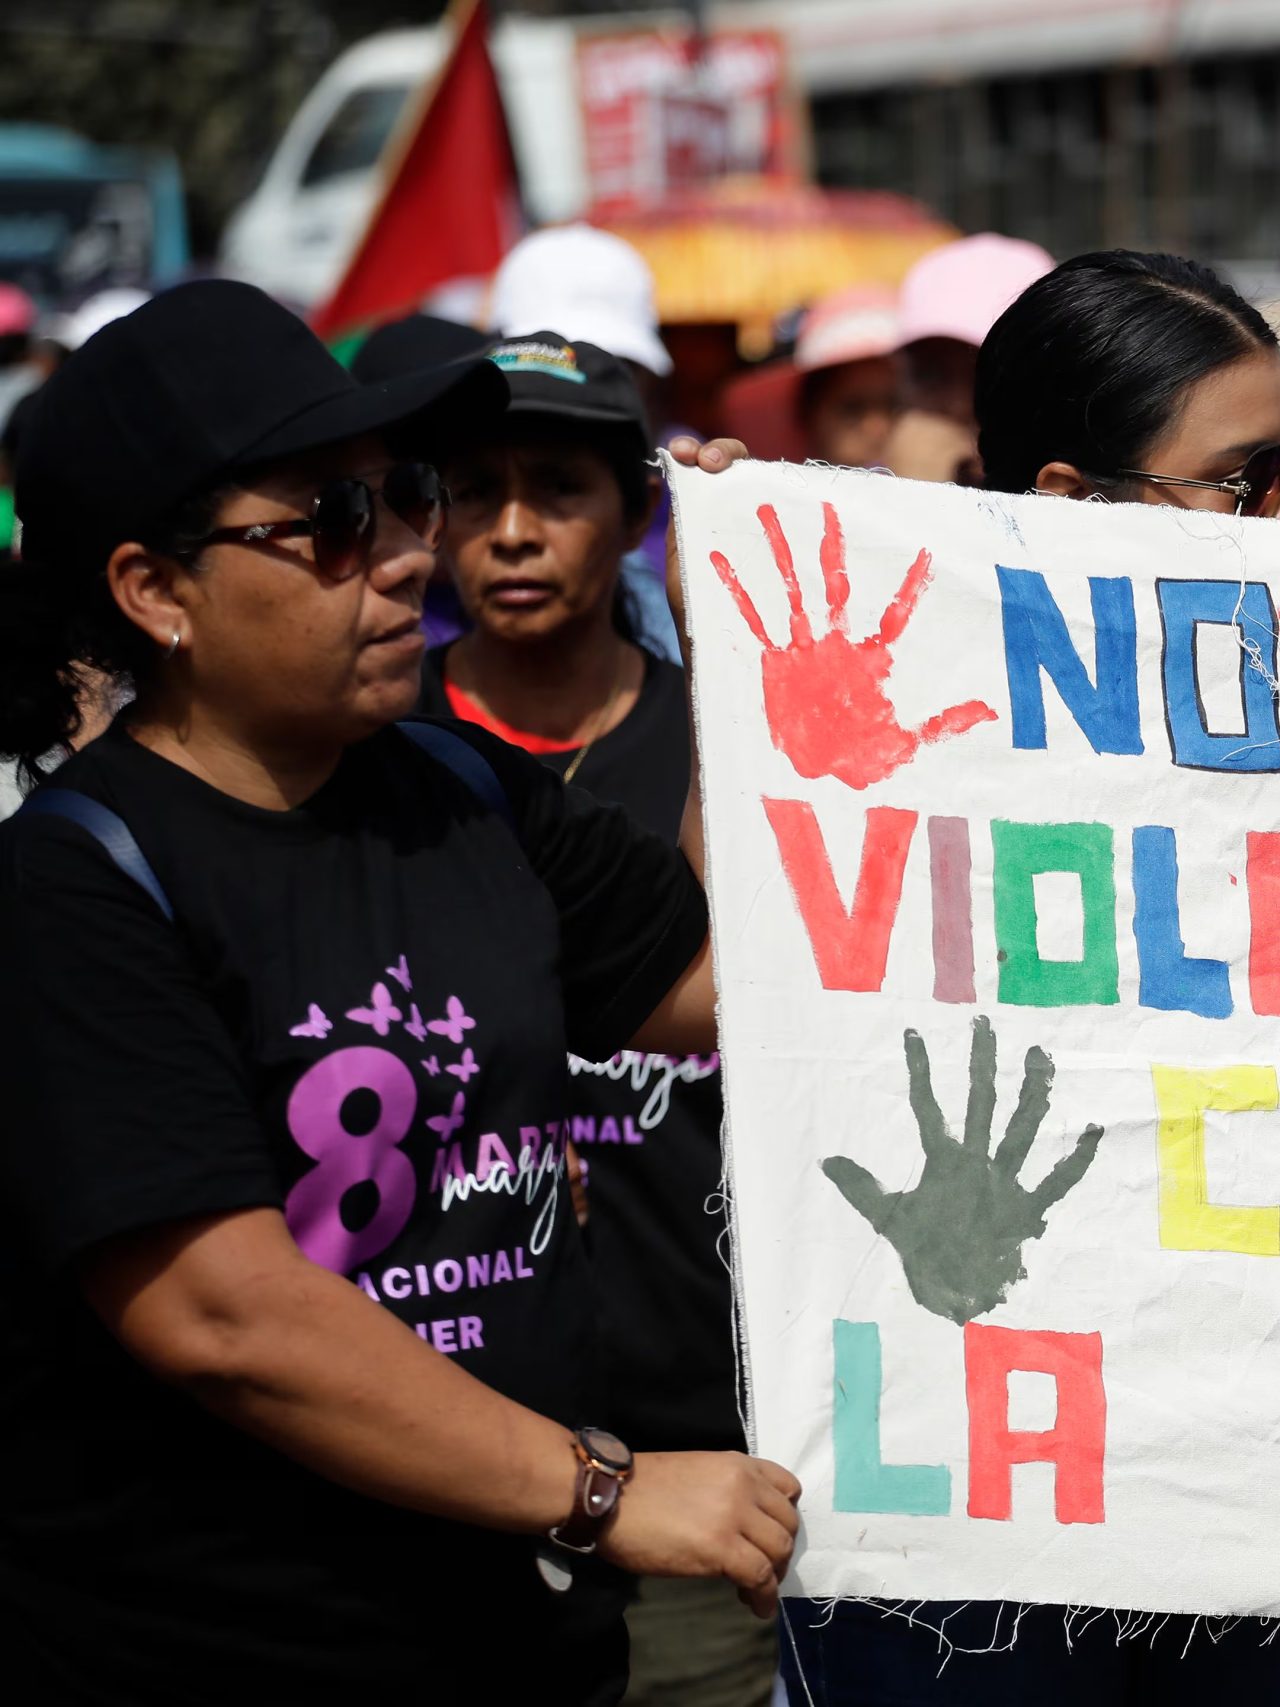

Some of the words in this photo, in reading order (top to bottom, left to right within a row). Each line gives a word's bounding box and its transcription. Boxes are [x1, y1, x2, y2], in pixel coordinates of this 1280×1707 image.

[286, 1046, 418, 1276] 8
[429, 1118, 569, 1195] MARZ
[833, 1318, 1107, 1525] LA
